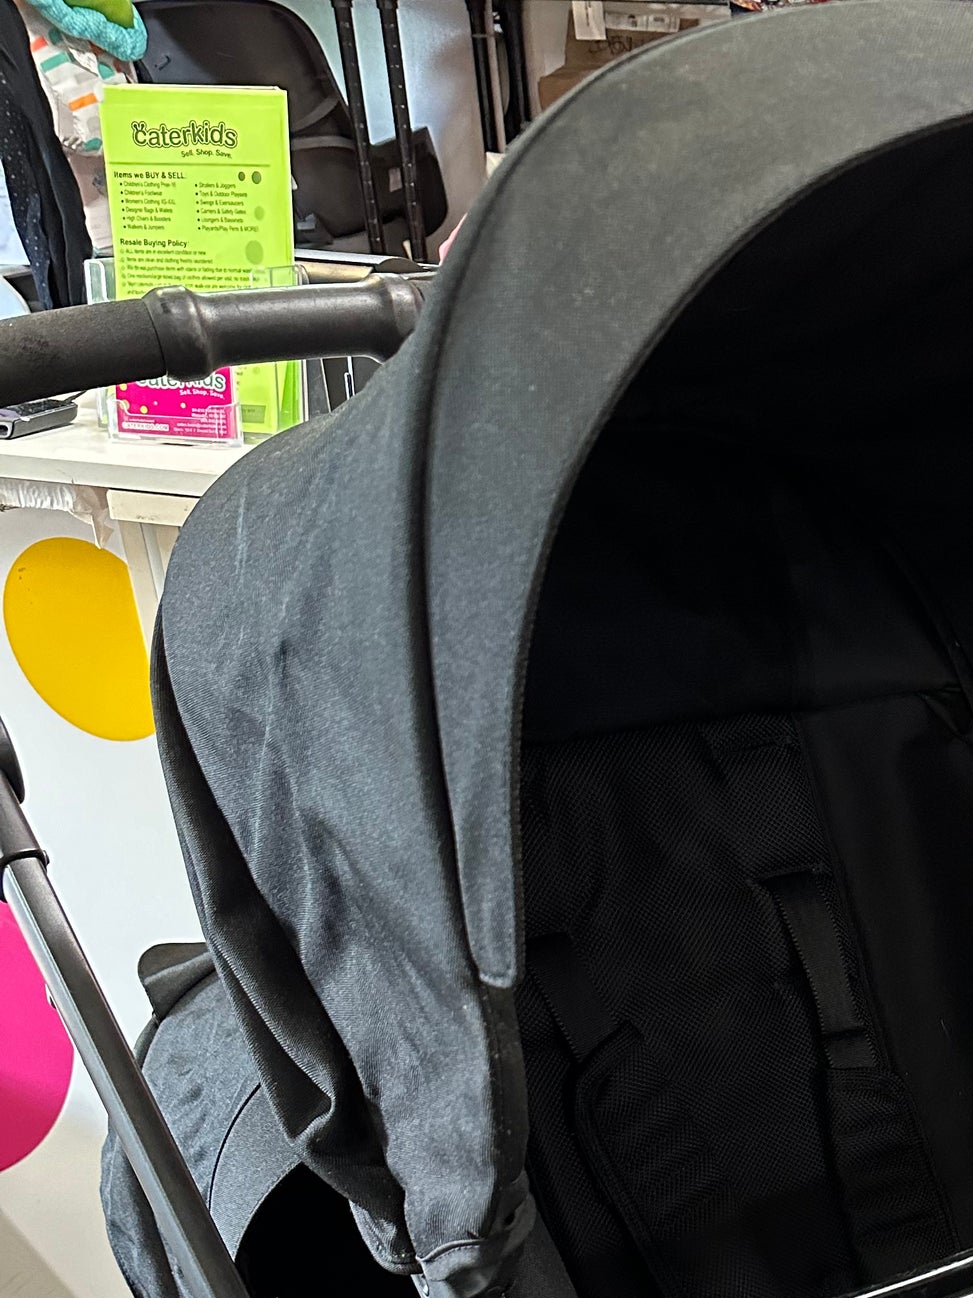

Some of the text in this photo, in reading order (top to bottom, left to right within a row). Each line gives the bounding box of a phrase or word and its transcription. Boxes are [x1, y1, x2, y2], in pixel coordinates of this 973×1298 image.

[181, 150, 194, 158] Sell.
[196, 149, 213, 157] Shop.
[144, 239, 166, 248] Buying
